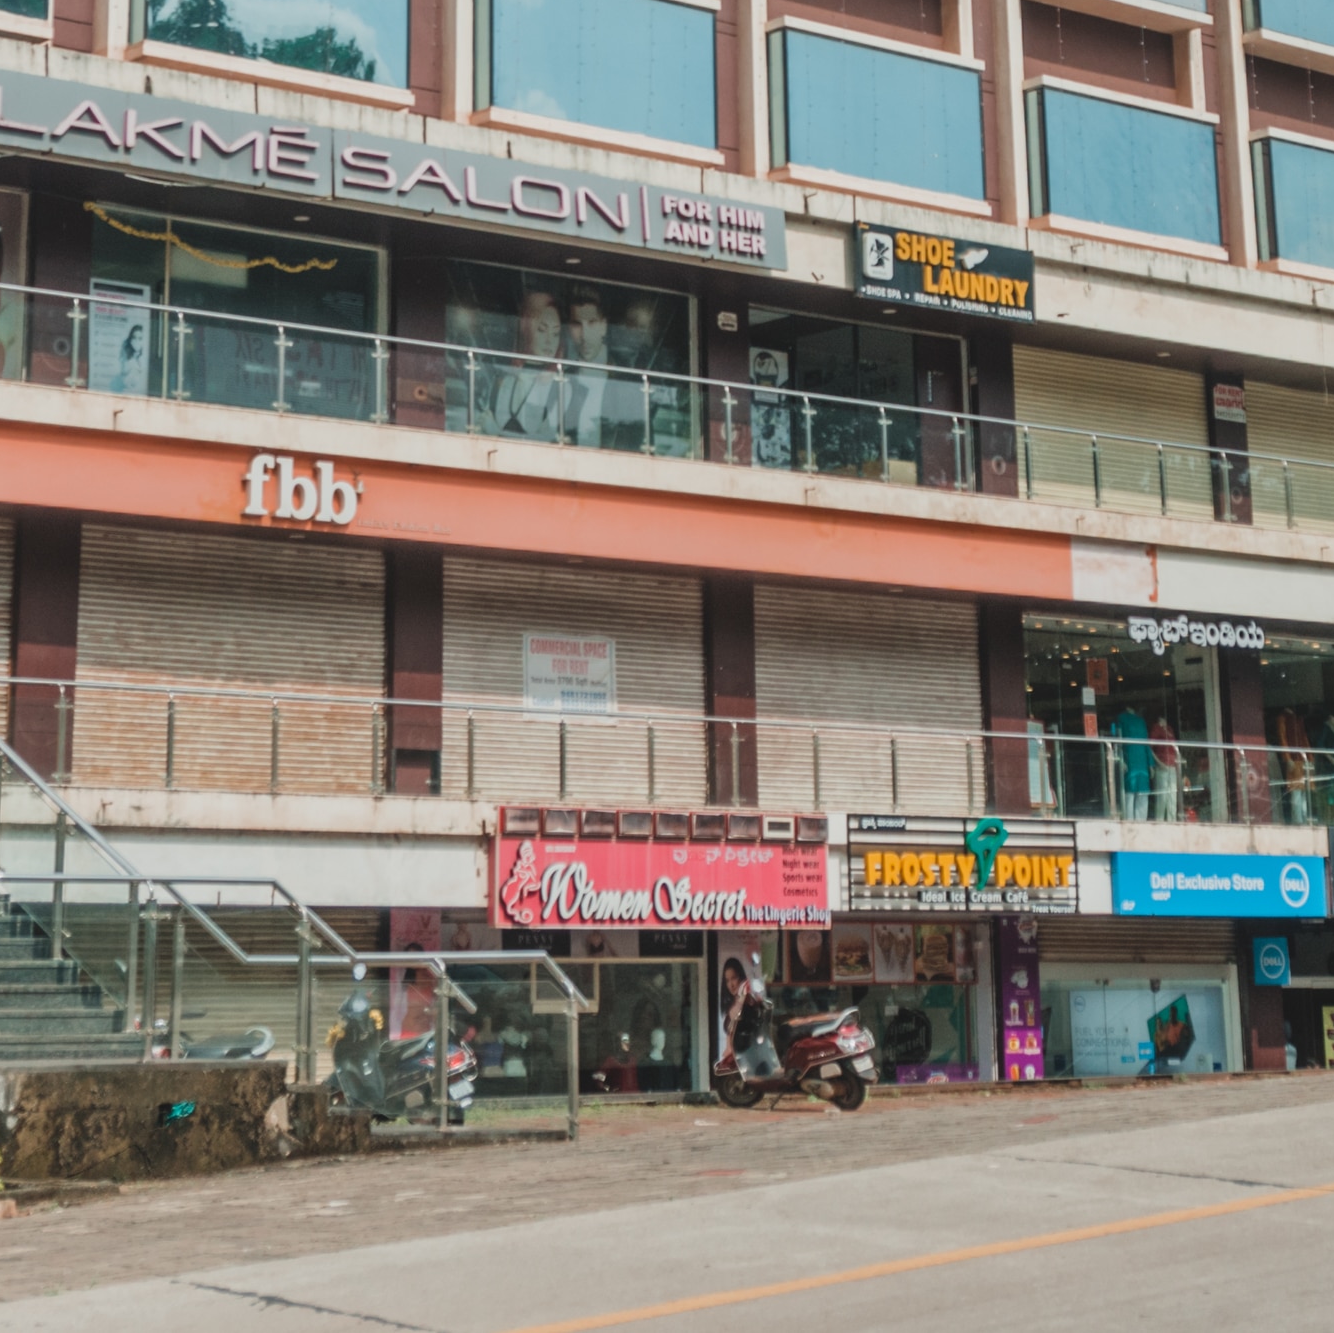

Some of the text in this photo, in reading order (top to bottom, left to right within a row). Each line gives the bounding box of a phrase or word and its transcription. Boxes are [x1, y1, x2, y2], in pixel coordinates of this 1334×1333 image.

[340, 146, 630, 230] SALON
[662, 194, 766, 232] FOR HIM
[666, 222, 767, 257] AND HER
[894, 231, 956, 269] SHOE
[867, 284, 885, 298] SHOE
[887, 287, 902, 300] SPA
[914, 292, 941, 306] REPAIR
[998, 307, 1033, 321] CLEANING
[922, 266, 1030, 309] LAUNDRY
[244, 452, 358, 526] fbb
[782, 859, 820, 872] Night wear
[782, 873, 823, 883] Sports wear
[865, 851, 1074, 888] FROSTY POINT
[1150, 871, 1265, 891] Dell Exclusive Store
[541, 861, 747, 922] Women Secret
[783, 887, 818, 897] Cosmetics
[922, 891, 947, 903] Ideal
[950, 892, 966, 903] Ice
[970, 892, 1002, 903] Cream
[1283, 878, 1307, 892] DELL
[744, 905, 832, 925] The Lingerie Shop
[1263, 957, 1283, 966] DELL
